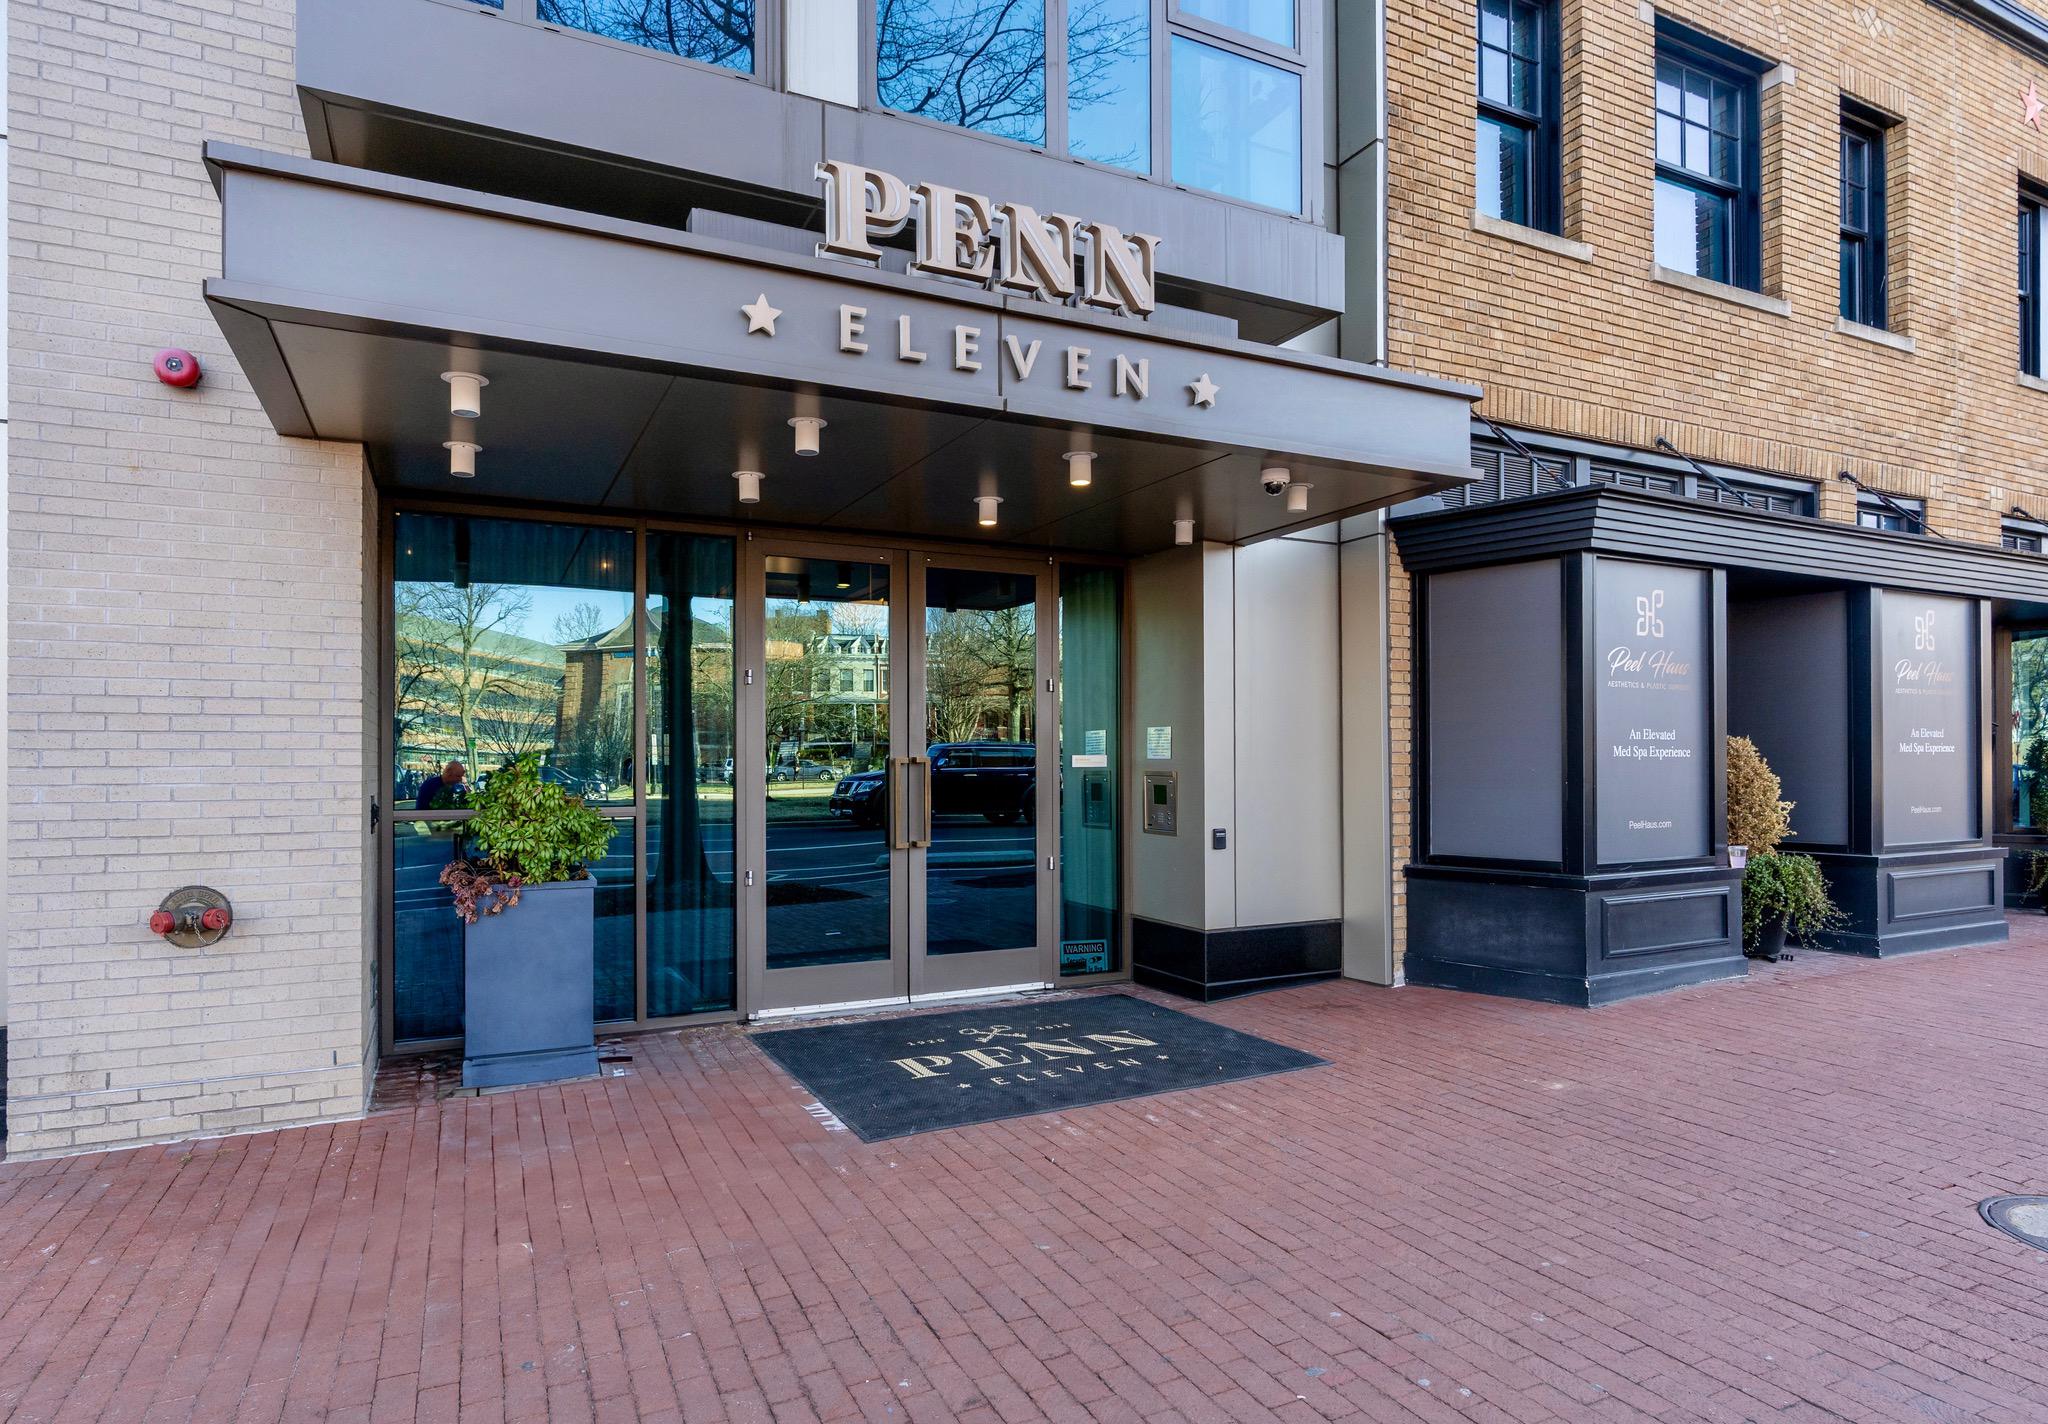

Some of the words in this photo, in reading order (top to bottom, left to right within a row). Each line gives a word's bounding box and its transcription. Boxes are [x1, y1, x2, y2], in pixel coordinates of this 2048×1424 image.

[814, 159, 1161, 321] PENN
[839, 303, 1150, 399] ELEVEN
[1607, 646, 1647, 677] Peel
[1648, 650, 1690, 678] Haus
[1894, 659, 1923, 685] Peel
[1629, 728, 1641, 740] An
[1643, 728, 1676, 740] Elevated
[1910, 728, 1920, 738] An
[1920, 728, 1944, 738] Elevated
[1613, 745, 1631, 757] Med
[1633, 745, 1648, 760] Spa
[1649, 745, 1691, 760] Experience
[1899, 742, 1913, 752] Med
[1913, 742, 1925, 755] Spa
[1925, 742, 1955, 755] Experience
[1629, 820, 1672, 830] PeelHaus.com
[1065, 943, 1103, 954] WARNING
[888, 1029, 1159, 1080] PENN
[990, 1058, 1142, 1085] ELEVEN
